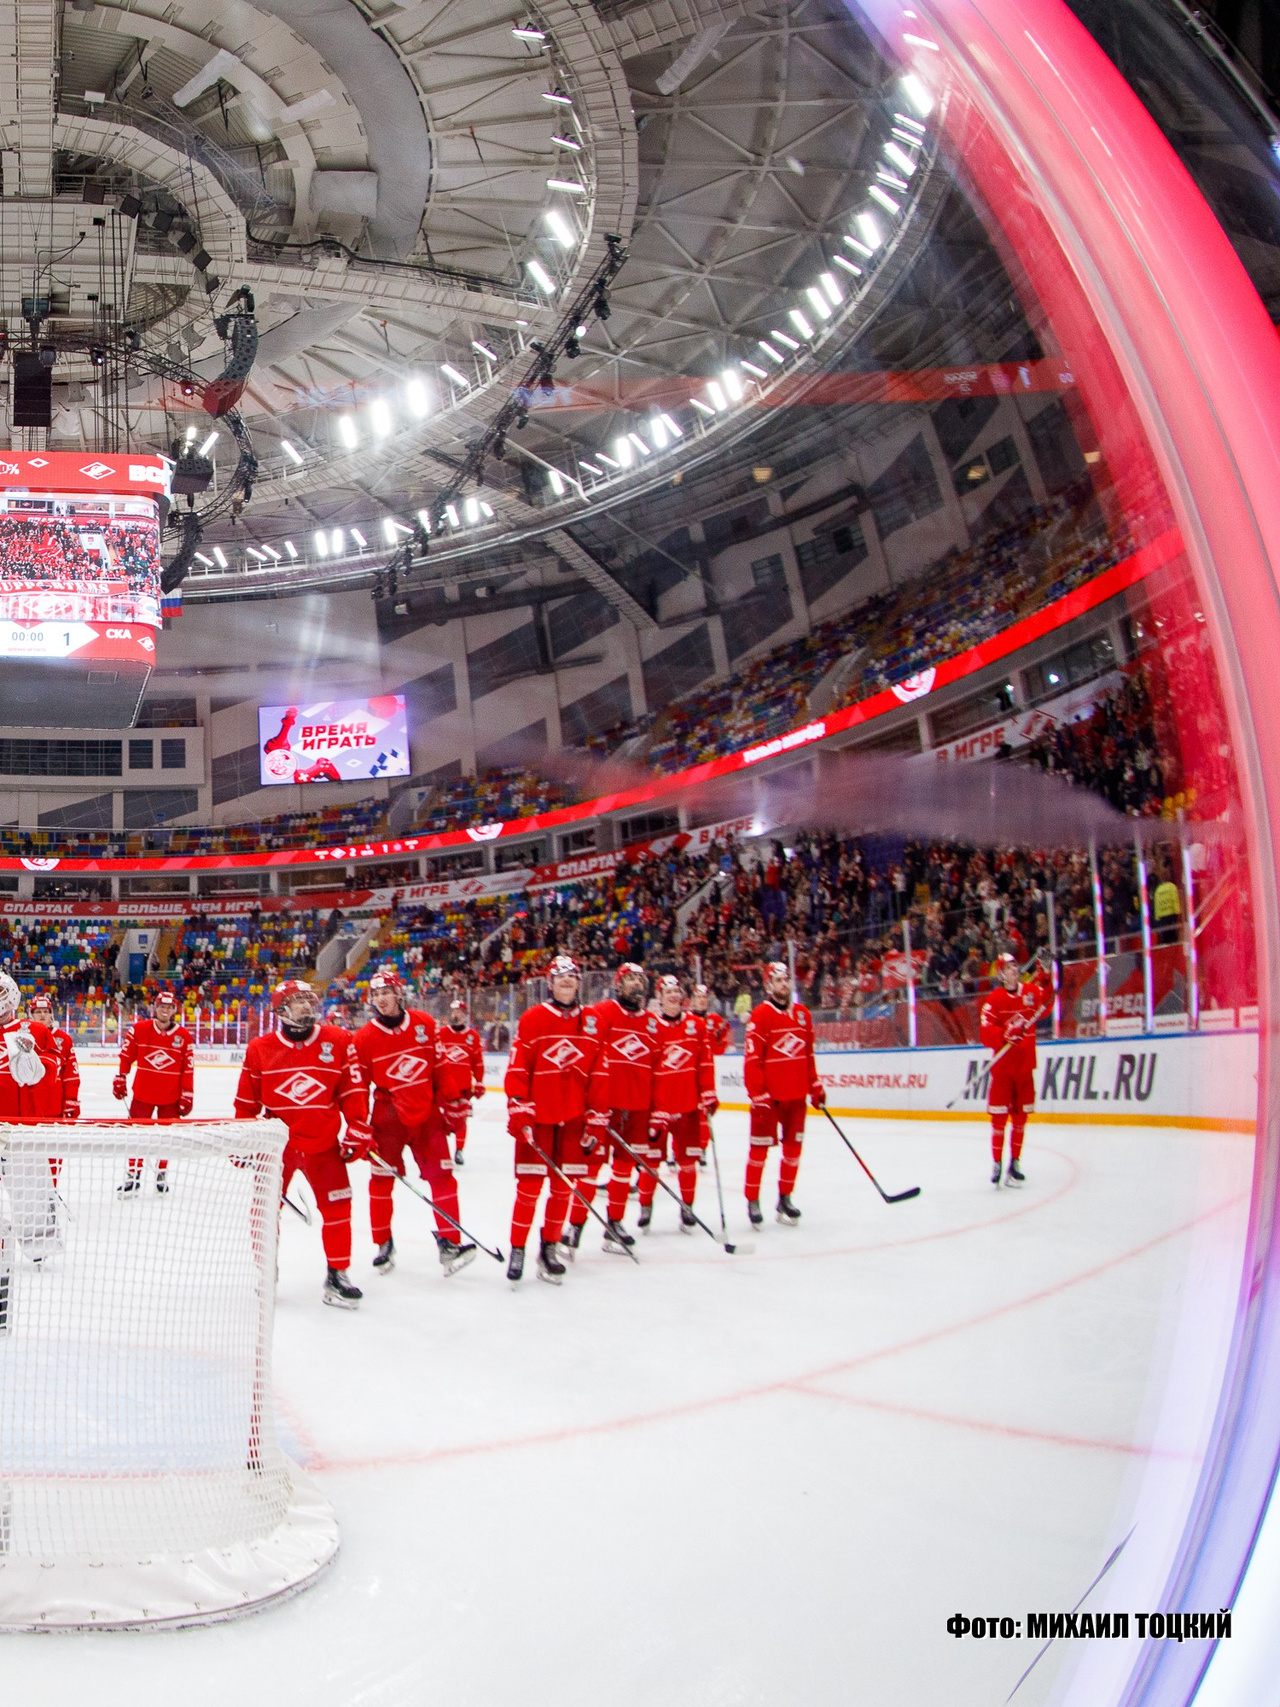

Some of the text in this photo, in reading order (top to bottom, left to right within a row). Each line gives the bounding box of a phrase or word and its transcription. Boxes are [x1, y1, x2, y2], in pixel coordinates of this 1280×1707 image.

[11, 631, 44, 642] 00:00
[63, 632, 71, 646] 1
[105, 628, 132, 640] СКА
[301, 722, 368, 738] ВРЕМЯ
[302, 735, 377, 750] ИГРАТЬ
[699, 828, 710, 845] В
[556, 850, 627, 878] СПАРТАК
[409, 883, 450, 898] ИГРЕ
[3, 902, 74, 914] СПАРТАК
[117, 900, 263, 915] БОЛЬШЕ, ЧЕМ ИГРА
[349, 1063, 362, 1084] 5
